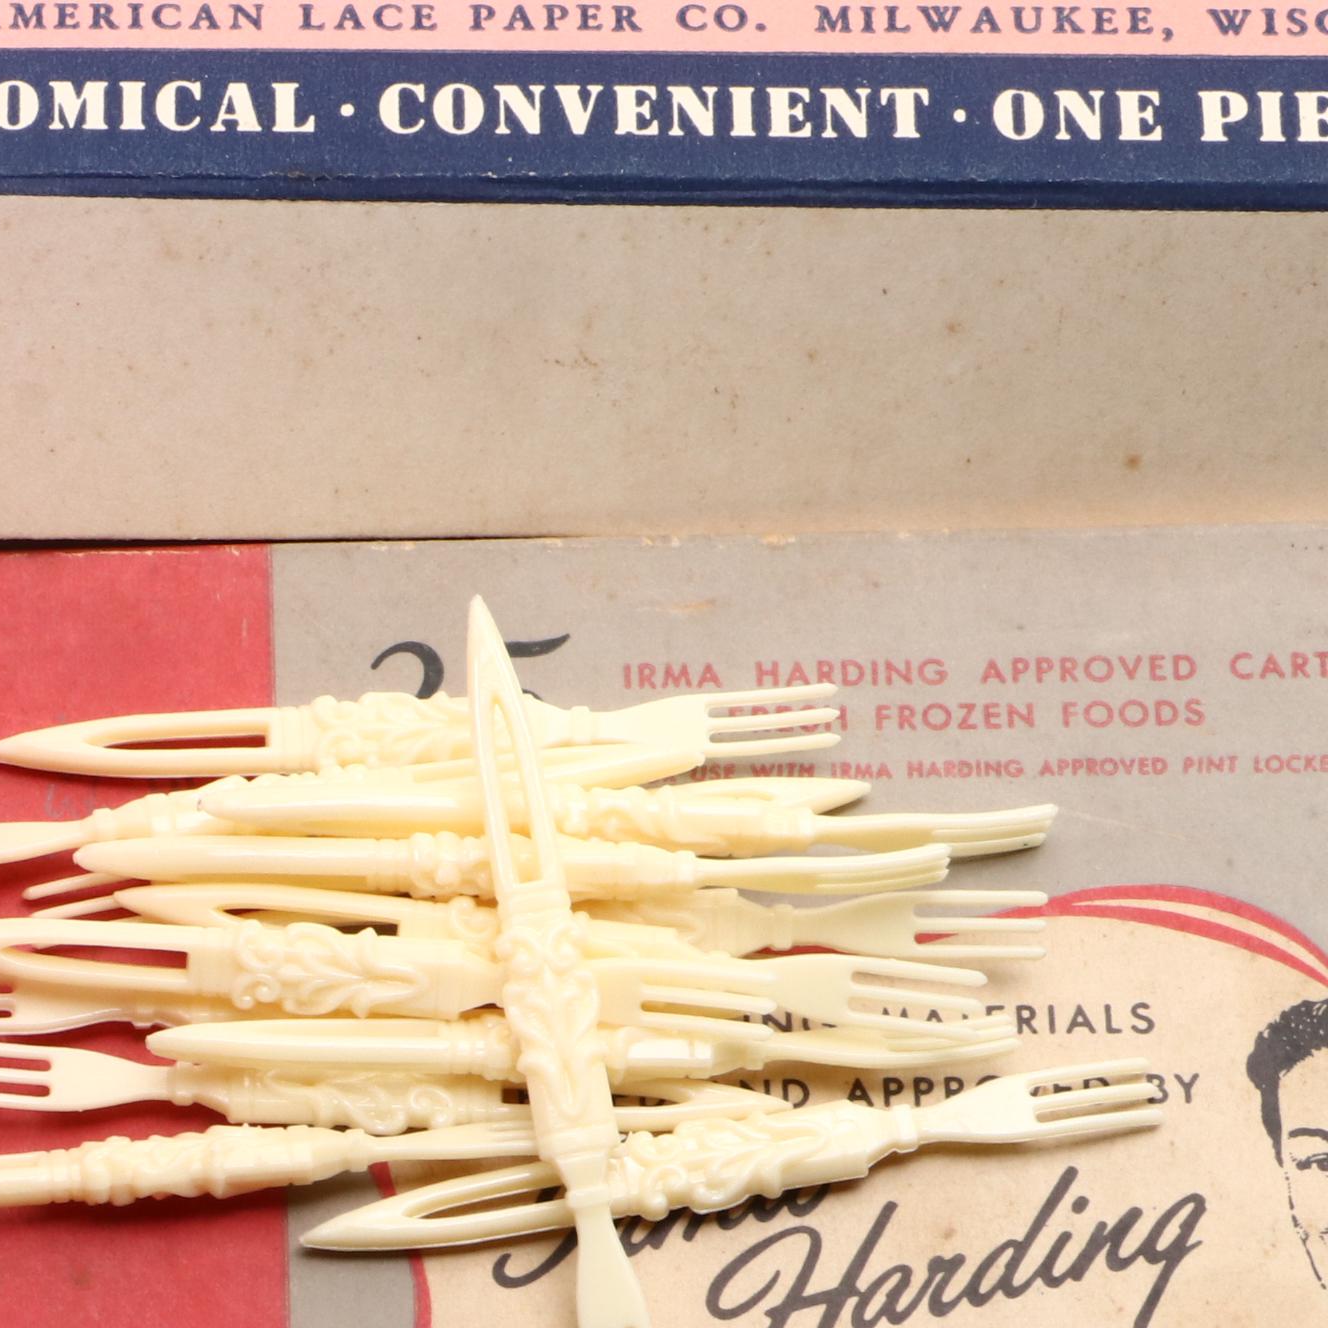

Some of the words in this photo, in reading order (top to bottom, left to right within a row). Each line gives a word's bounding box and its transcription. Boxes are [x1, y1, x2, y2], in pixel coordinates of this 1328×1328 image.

[298, 3, 438, 31] LACE
[469, 4, 643, 32] PAPER
[675, 4, 768, 33] CO.
[815, 5, 1174, 42] MILWAUKEE,
[378, 83, 930, 138] CONVENIENT
[992, 88, 1164, 142] ONE
[1197, 90, 1328, 142] PIE
[622, 661, 722, 690] IRMA
[754, 657, 949, 688] HARDING
[979, 653, 1199, 684] APPROVED
[1228, 650, 1328, 681] CART
[874, 701, 1035, 732] FROZEN
[1060, 697, 1208, 729] FOODS
[688, 762, 736, 780] USE
[750, 761, 816, 778] WITH
[830, 761, 894, 780] IRMA
[906, 758, 1025, 779] HARDING
[1038, 755, 1170, 778] APPROVED
[1182, 753, 1240, 775] PINT
[1253, 752, 1328, 775] LOCKE
[1145, 1072, 1201, 1105] BY
